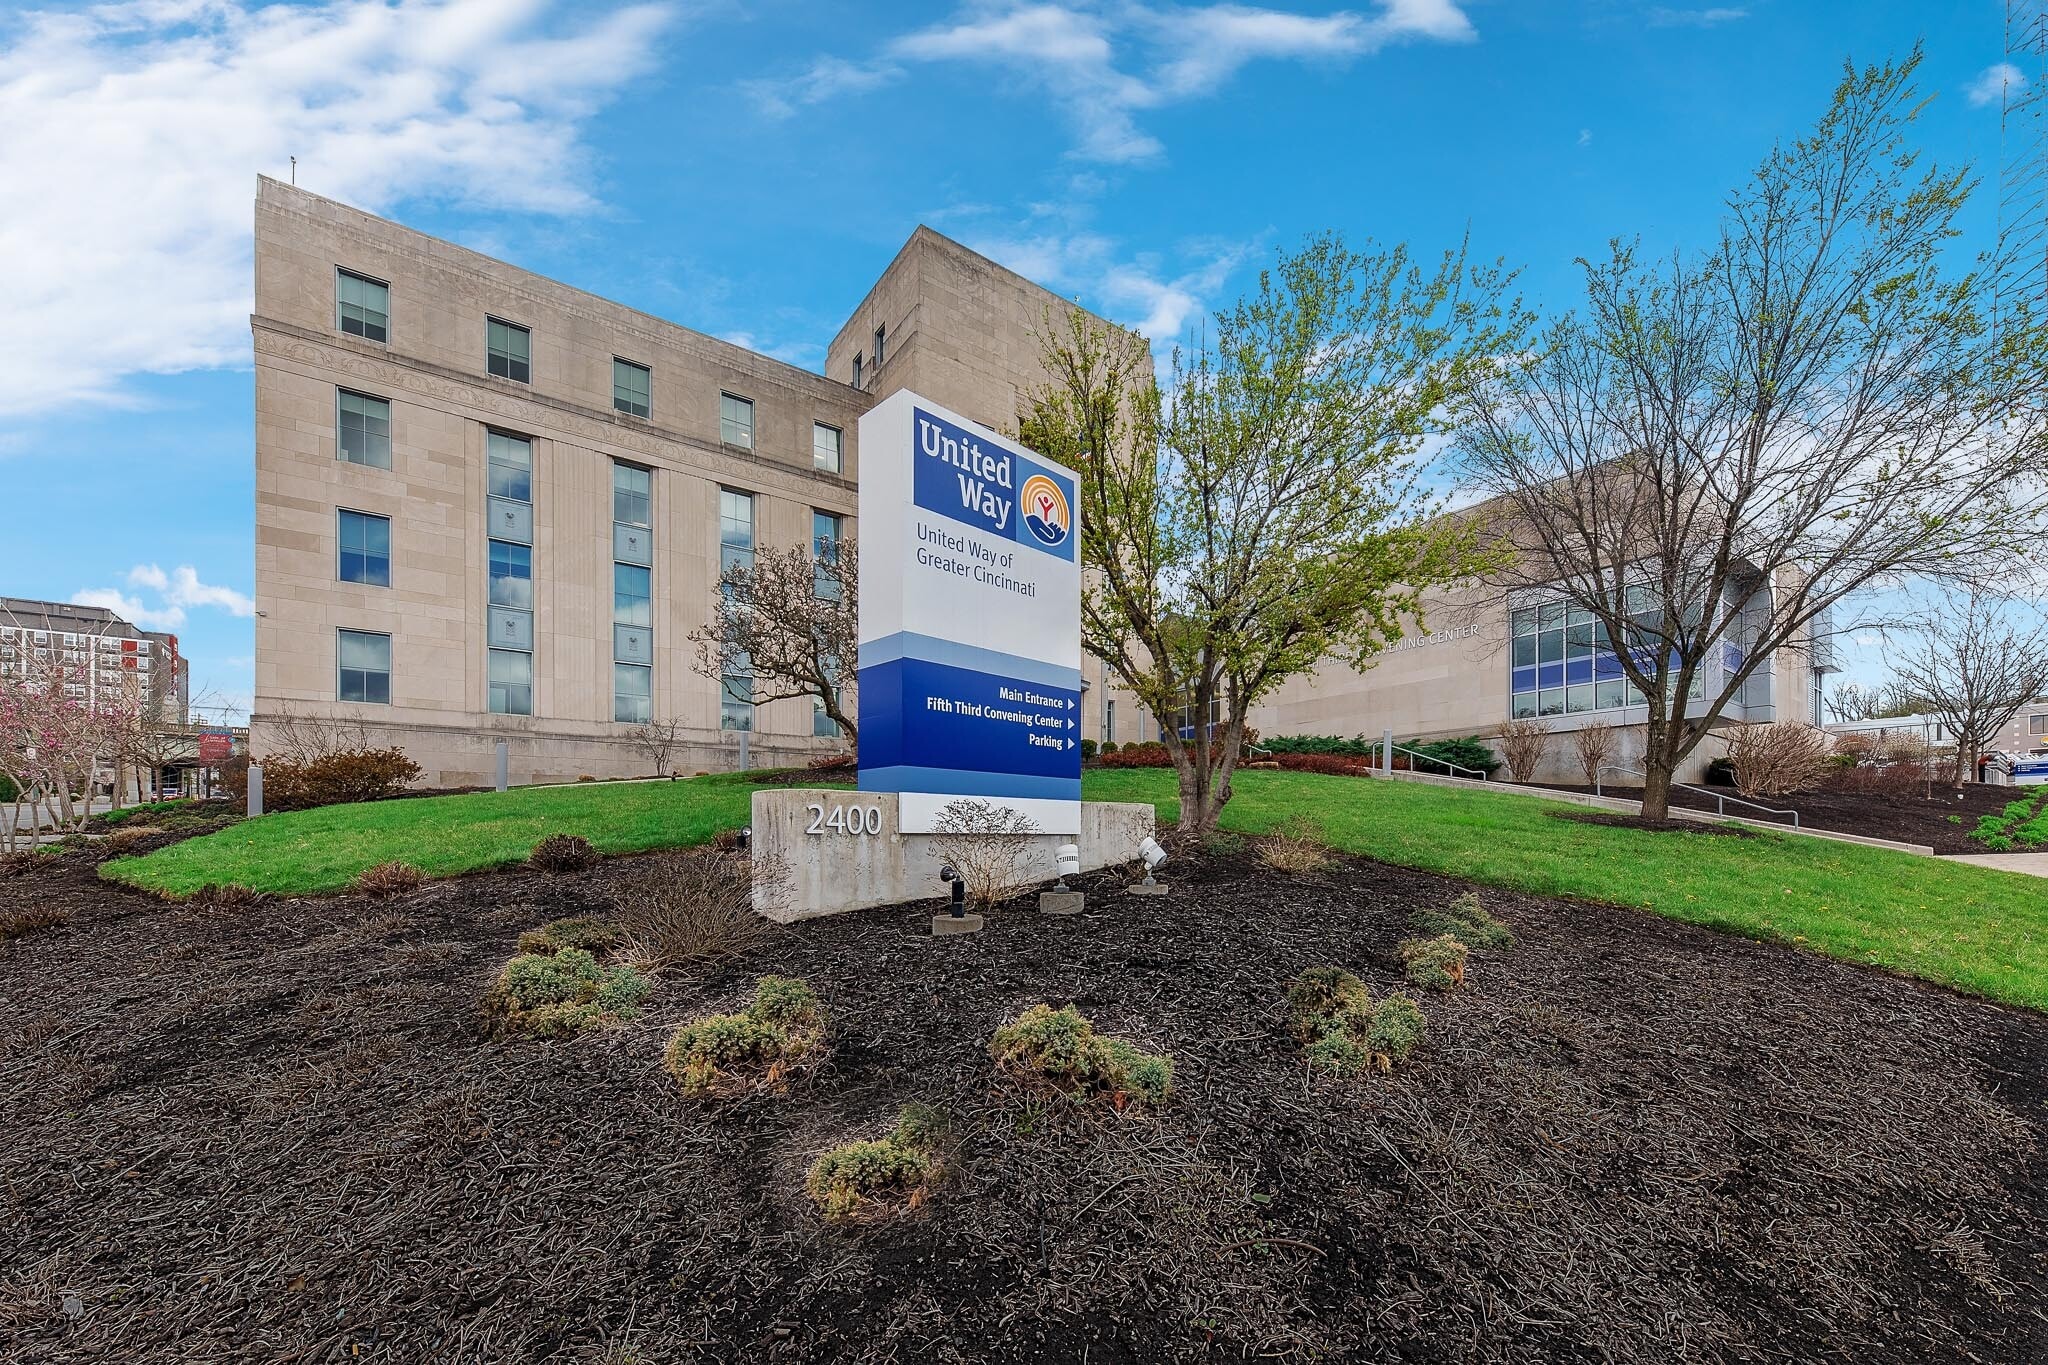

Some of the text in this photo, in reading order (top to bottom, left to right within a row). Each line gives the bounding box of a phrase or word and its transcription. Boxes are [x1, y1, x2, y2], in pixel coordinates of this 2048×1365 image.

[920, 419, 1012, 489] United
[957, 473, 1011, 530] Way
[917, 522, 1013, 569] United Way of
[916, 547, 1035, 598] Greater Cincinnati
[1429, 624, 1479, 645] CENTER
[927, 697, 1063, 728] Fifth Third Convening Center
[999, 686, 1063, 709] Main Entrance
[1029, 733, 1063, 750] Parking
[805, 803, 882, 835] 2400
